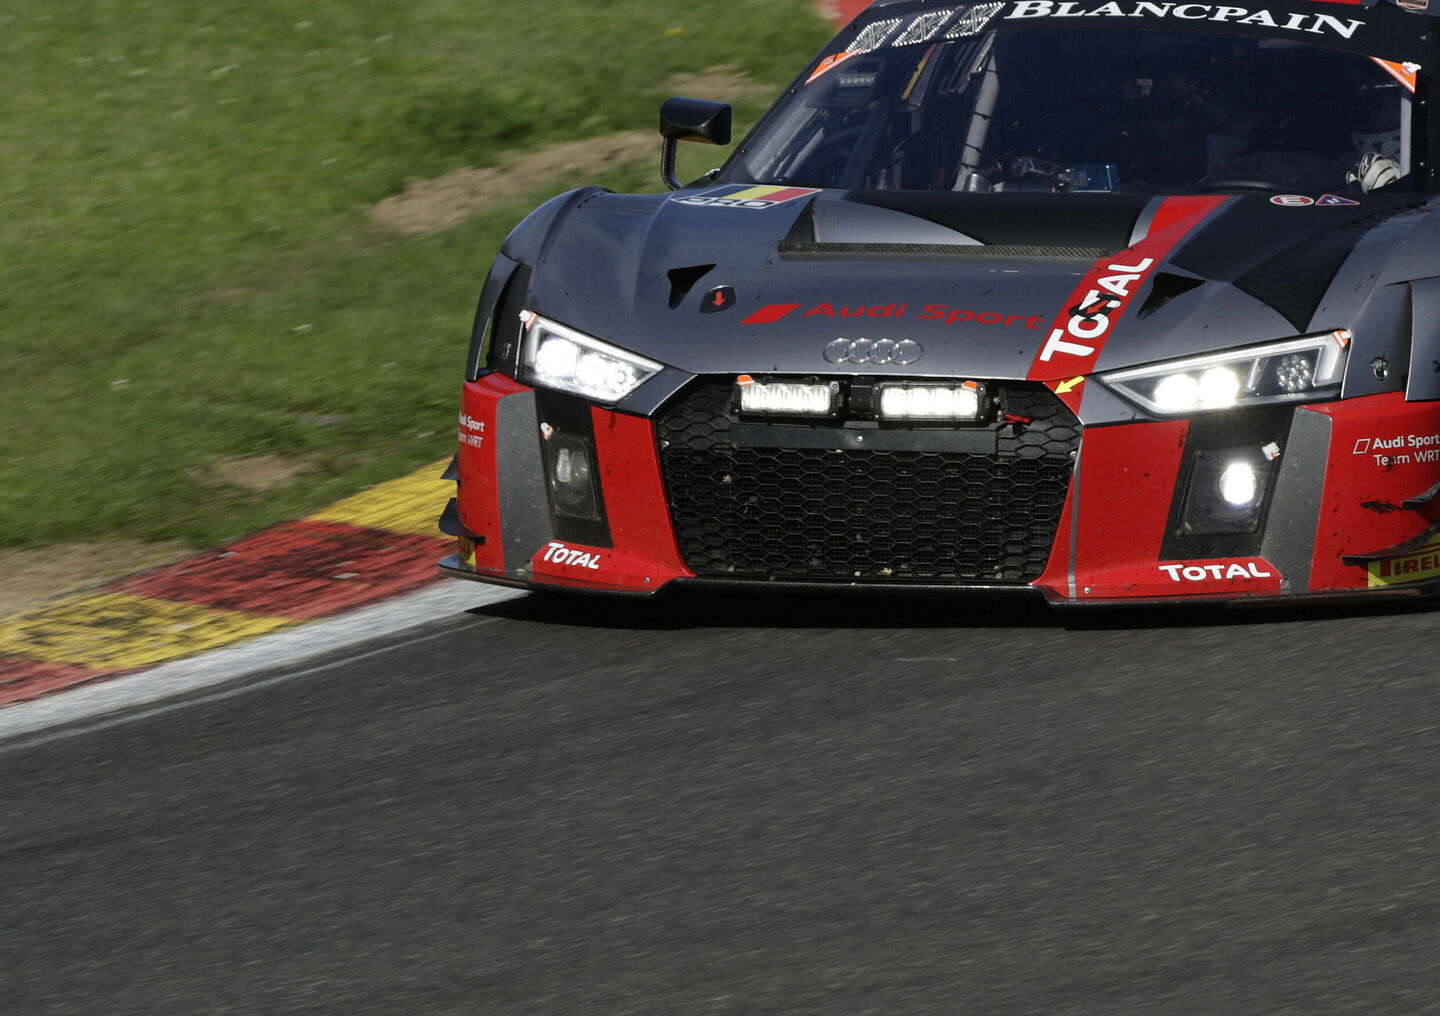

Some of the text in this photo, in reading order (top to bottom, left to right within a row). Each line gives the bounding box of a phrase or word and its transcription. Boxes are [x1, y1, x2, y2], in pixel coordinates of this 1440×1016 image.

[1003, 0, 1366, 40] BLANCPAIN
[803, 302, 1045, 331] Audi Sport
[1372, 434, 1440, 450] Audi Sport
[1373, 449, 1440, 467] Team WRT
[543, 541, 601, 570] TOTAL
[1158, 562, 1271, 582] TOTAL
